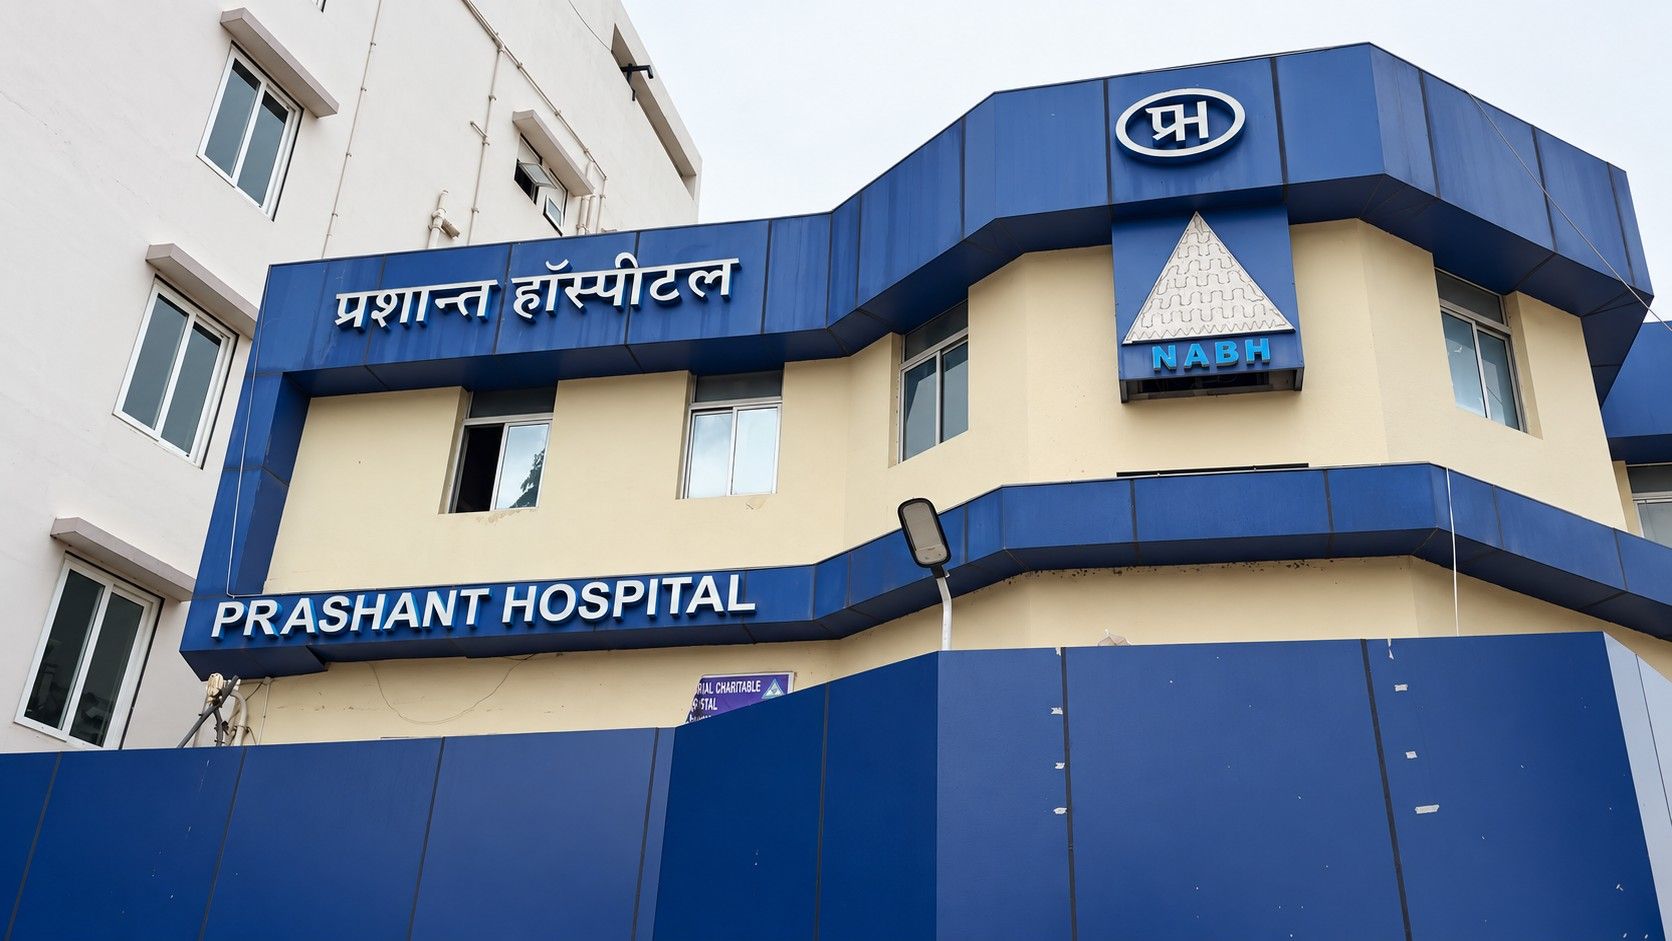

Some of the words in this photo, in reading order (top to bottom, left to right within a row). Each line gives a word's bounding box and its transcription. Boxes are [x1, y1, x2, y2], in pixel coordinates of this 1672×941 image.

[335, 279, 499, 328] प्रशान्त
[511, 252, 739, 320] हॉस्पीटल
[1152, 338, 1271, 371] NABH
[211, 587, 490, 639] PRASHANT
[502, 574, 757, 623] HOSPITAL
[715, 680, 761, 693] CHARITABLE
